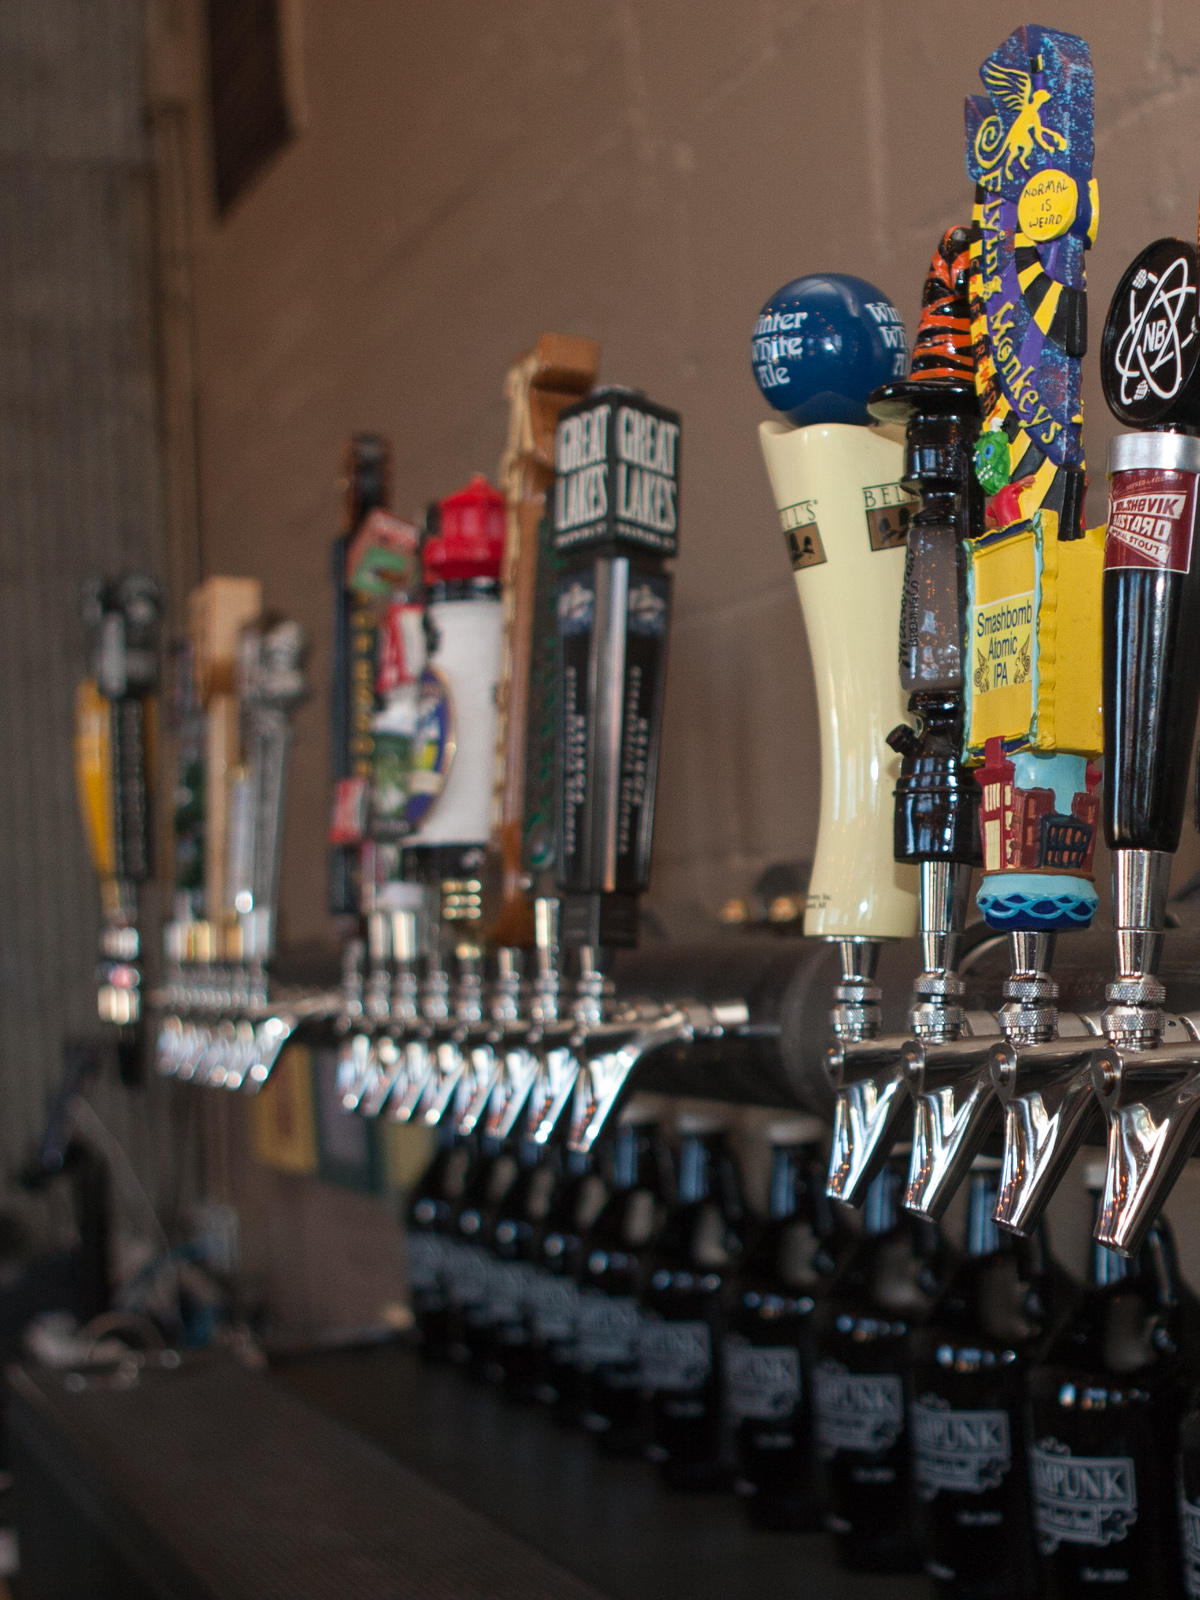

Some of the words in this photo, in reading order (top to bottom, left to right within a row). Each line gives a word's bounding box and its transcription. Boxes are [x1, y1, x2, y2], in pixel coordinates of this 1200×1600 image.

[1023, 180, 1069, 198] NORMAL
[1041, 199, 1052, 212] IS
[1029, 214, 1063, 229] WEIRD
[754, 311, 809, 336] inter
[1143, 318, 1168, 354] NB
[757, 363, 791, 389] Ale
[988, 301, 1063, 444] Monkeys
[556, 404, 612, 474] GREAT
[615, 406, 681, 476] GREAT
[555, 462, 609, 532] LAKES
[615, 462, 678, 533] LAKES
[1129, 534, 1161, 556] STOUT
[977, 598, 1033, 638] Smashbomb
[987, 631, 1018, 662] Atomic
[993, 661, 1009, 688] IPA
